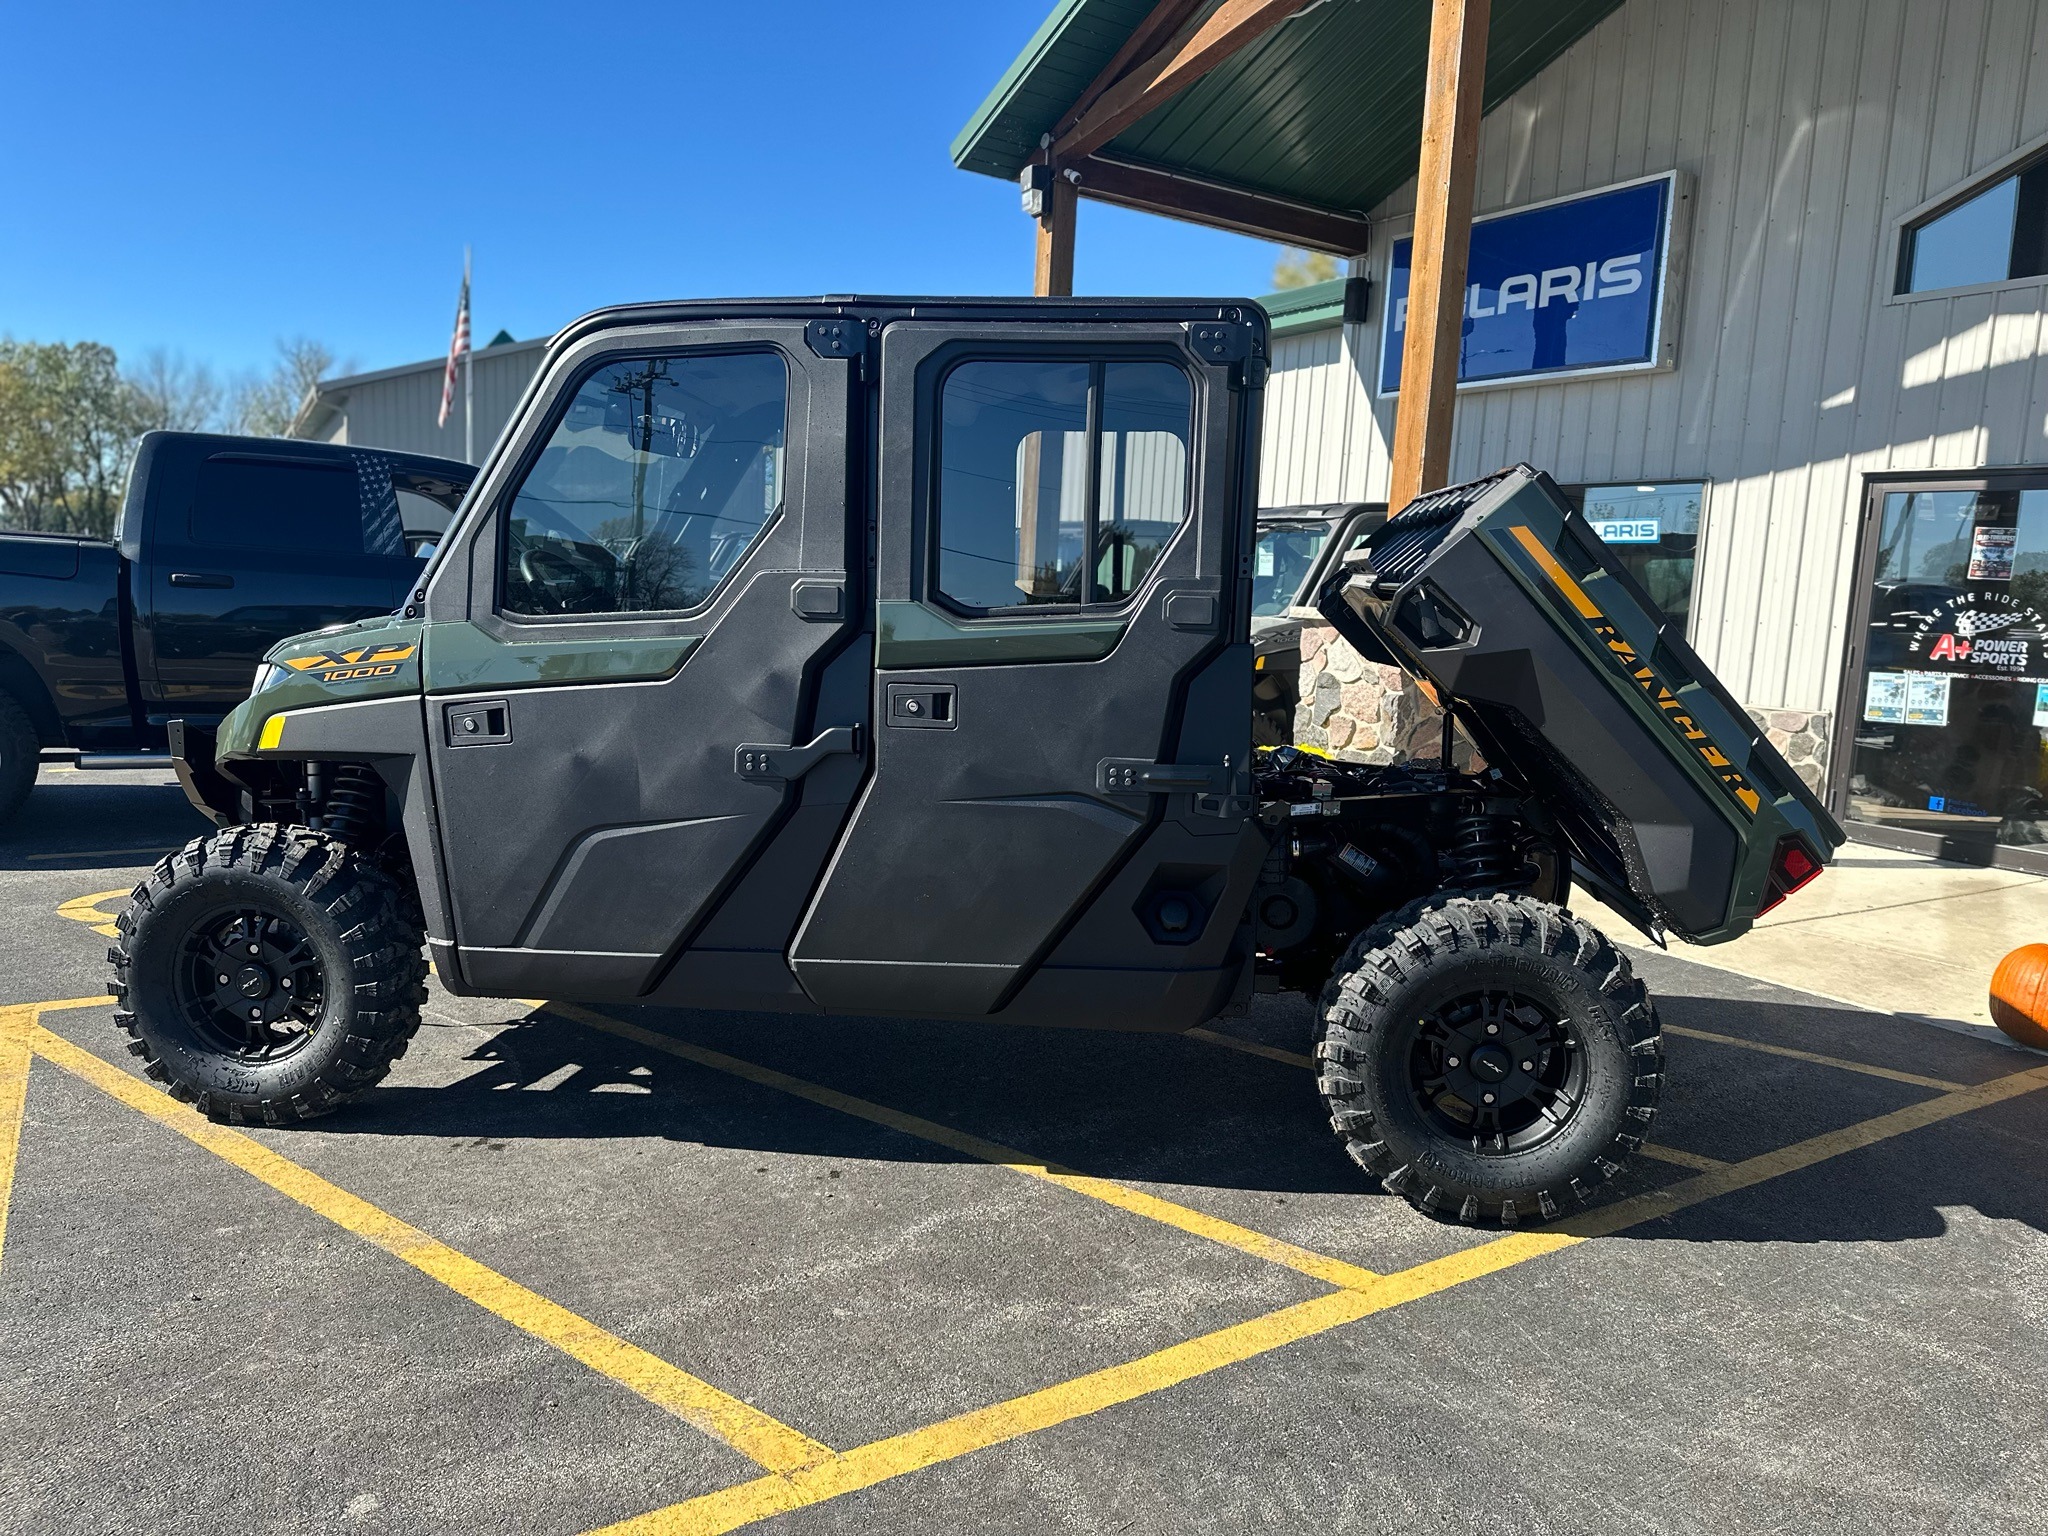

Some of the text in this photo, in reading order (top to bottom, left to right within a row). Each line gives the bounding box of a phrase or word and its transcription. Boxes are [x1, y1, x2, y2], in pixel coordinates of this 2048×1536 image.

[1394, 253, 1643, 332] LARIS
[1593, 524, 1655, 538] ARIS
[1909, 608, 1942, 651] WHERE
[1946, 592, 1976, 608] THE
[1984, 592, 2020, 608] RIDE
[303, 641, 413, 669] XP
[1929, 633, 2029, 661] A+ POWER
[1970, 652, 2028, 666] SPORTS
[323, 665, 398, 682] 1000
[1594, 626, 1760, 815] RANGER
[1947, 805, 1989, 817] Facebook
